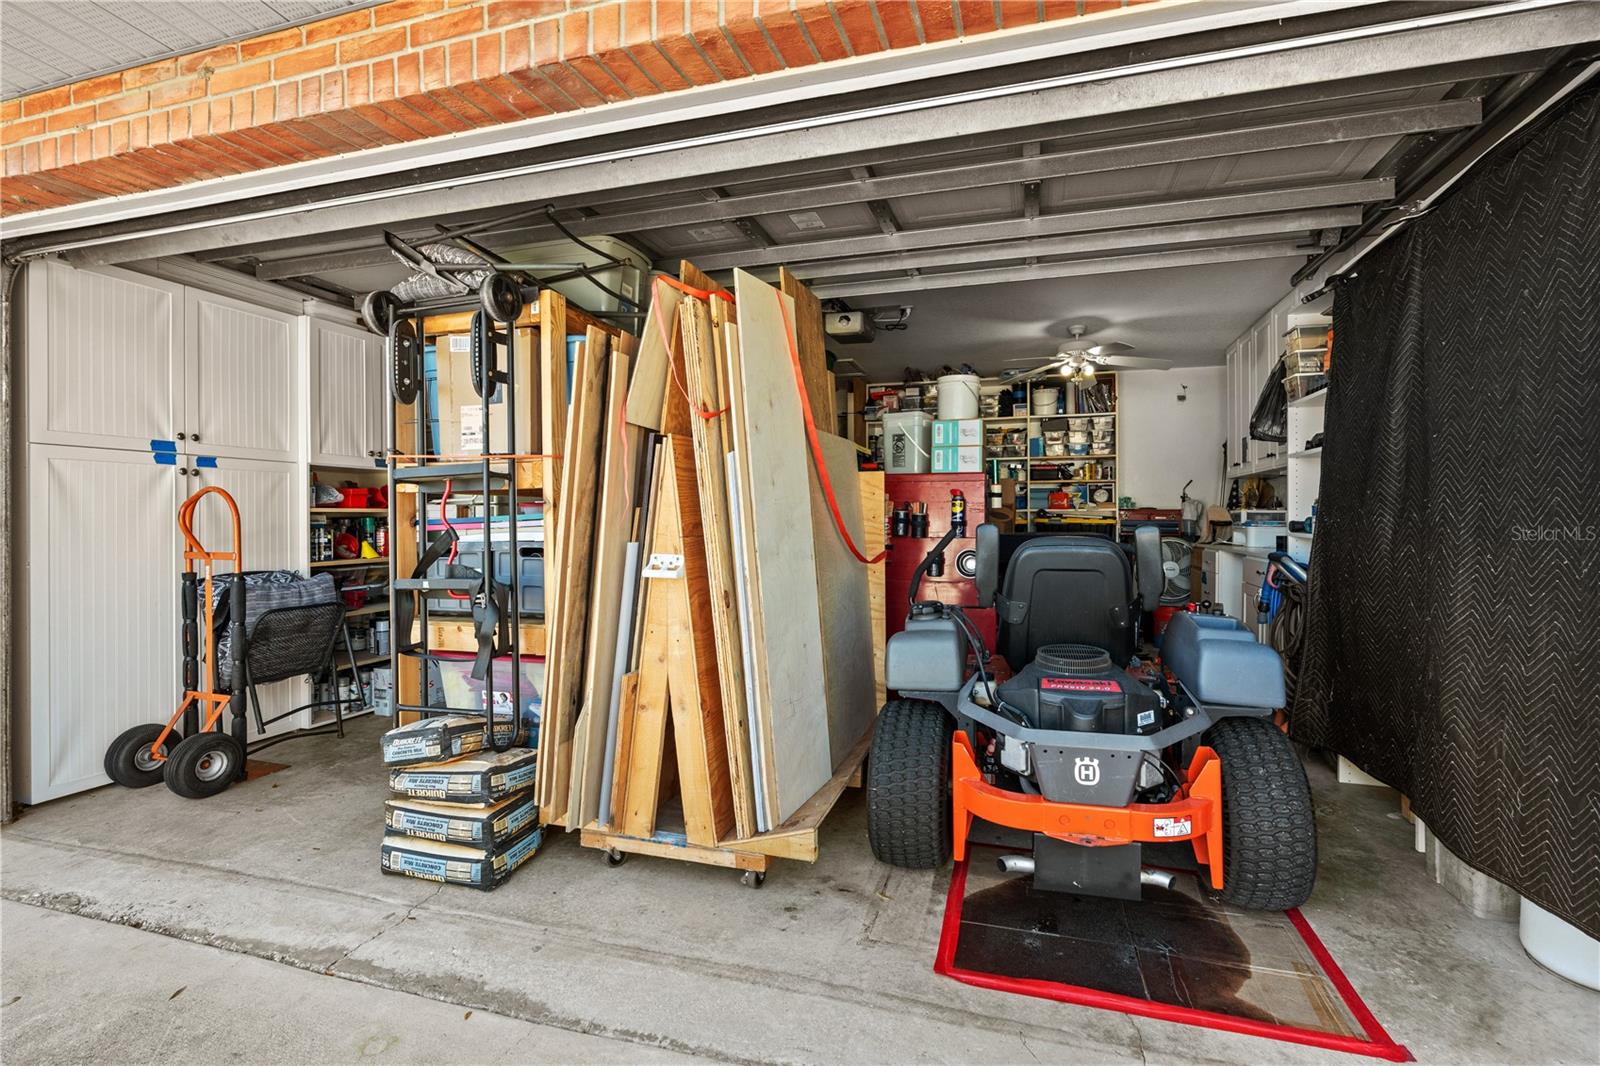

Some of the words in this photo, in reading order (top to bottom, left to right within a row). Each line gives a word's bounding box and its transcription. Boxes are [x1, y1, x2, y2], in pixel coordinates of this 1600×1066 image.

[407, 789, 446, 799] QUIKRETE
[417, 819, 443, 829] CONCRETE
[406, 829, 446, 842] QUIKRETE
[415, 862, 441, 871] CONCRETE
[405, 870, 445, 882] QUIKRETE
